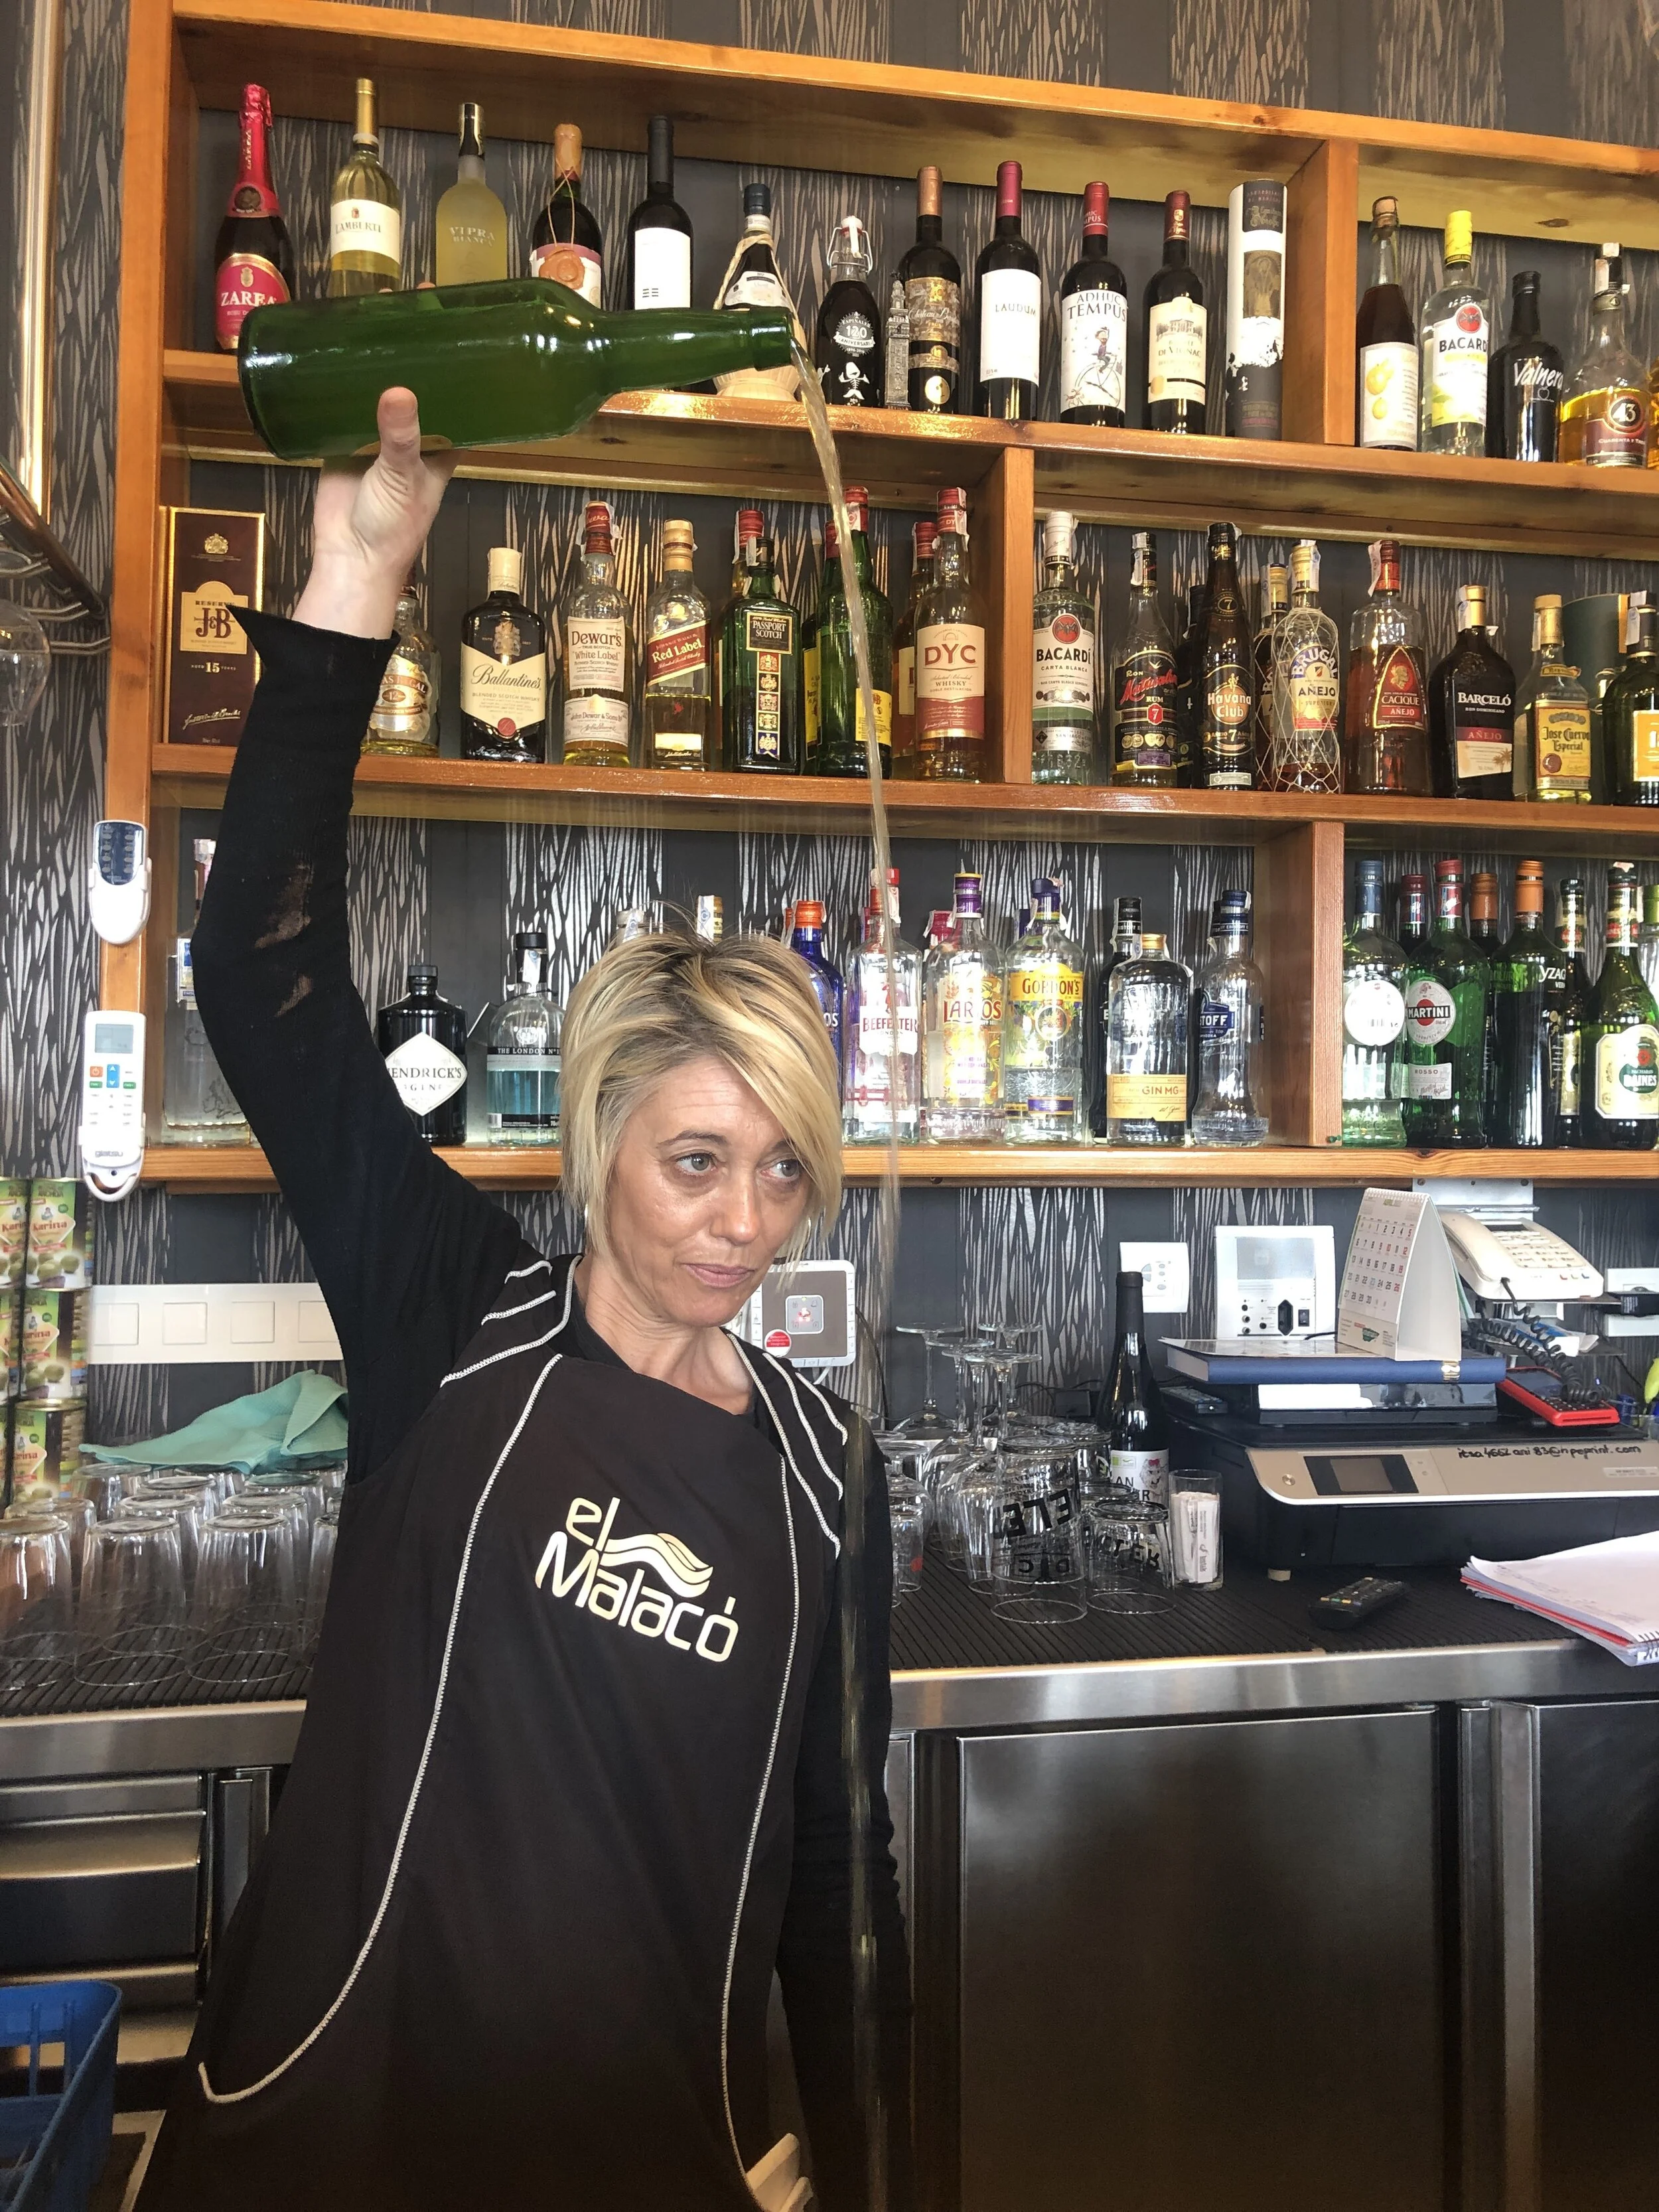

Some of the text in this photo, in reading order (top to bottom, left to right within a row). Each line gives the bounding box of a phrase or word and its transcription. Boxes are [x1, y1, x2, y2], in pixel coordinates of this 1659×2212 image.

[449, 226, 495, 242] VIPRA
[1076, 292, 1121, 305] ADHUC
[995, 303, 1037, 317] LAUDUM
[1067, 303, 1127, 322] TEMPUS
[845, 325, 867, 339] 120
[1610, 402, 1636, 423] 43
[752, 621, 787, 632] PASSPORT
[571, 630, 622, 648] Dewar's
[755, 629, 783, 639] SCOTCH
[652, 637, 705, 663] Red Label
[924, 643, 977, 666] DYC
[1036, 648, 1092, 664] BACARDÍ
[205, 662, 221, 674] 15
[1291, 647, 1338, 677] BRUGAL
[470, 664, 541, 691] Ballantine's
[1298, 684, 1336, 698] AÑEJO
[1207, 692, 1252, 705] Havana
[1381, 695, 1421, 706] CACIQUE
[1457, 692, 1512, 706] BARCELÓ
[1151, 708, 1160, 720] 7
[1216, 705, 1244, 718] Club
[1390, 707, 1415, 716] AÑEJO
[1228, 729, 1238, 742] 7
[1468, 730, 1503, 740] AÑEJO
[1551, 739, 1583, 753] Especial
[1408, 1007, 1449, 1019] MARTINI
[863, 1017, 918, 1033] BEEFETER
[1142, 1086, 1179, 1095] GIN MG
[33, 1220, 67, 1232] Karina
[565, 1496, 620, 1552] el
[534, 1530, 739, 1662] Malacó
